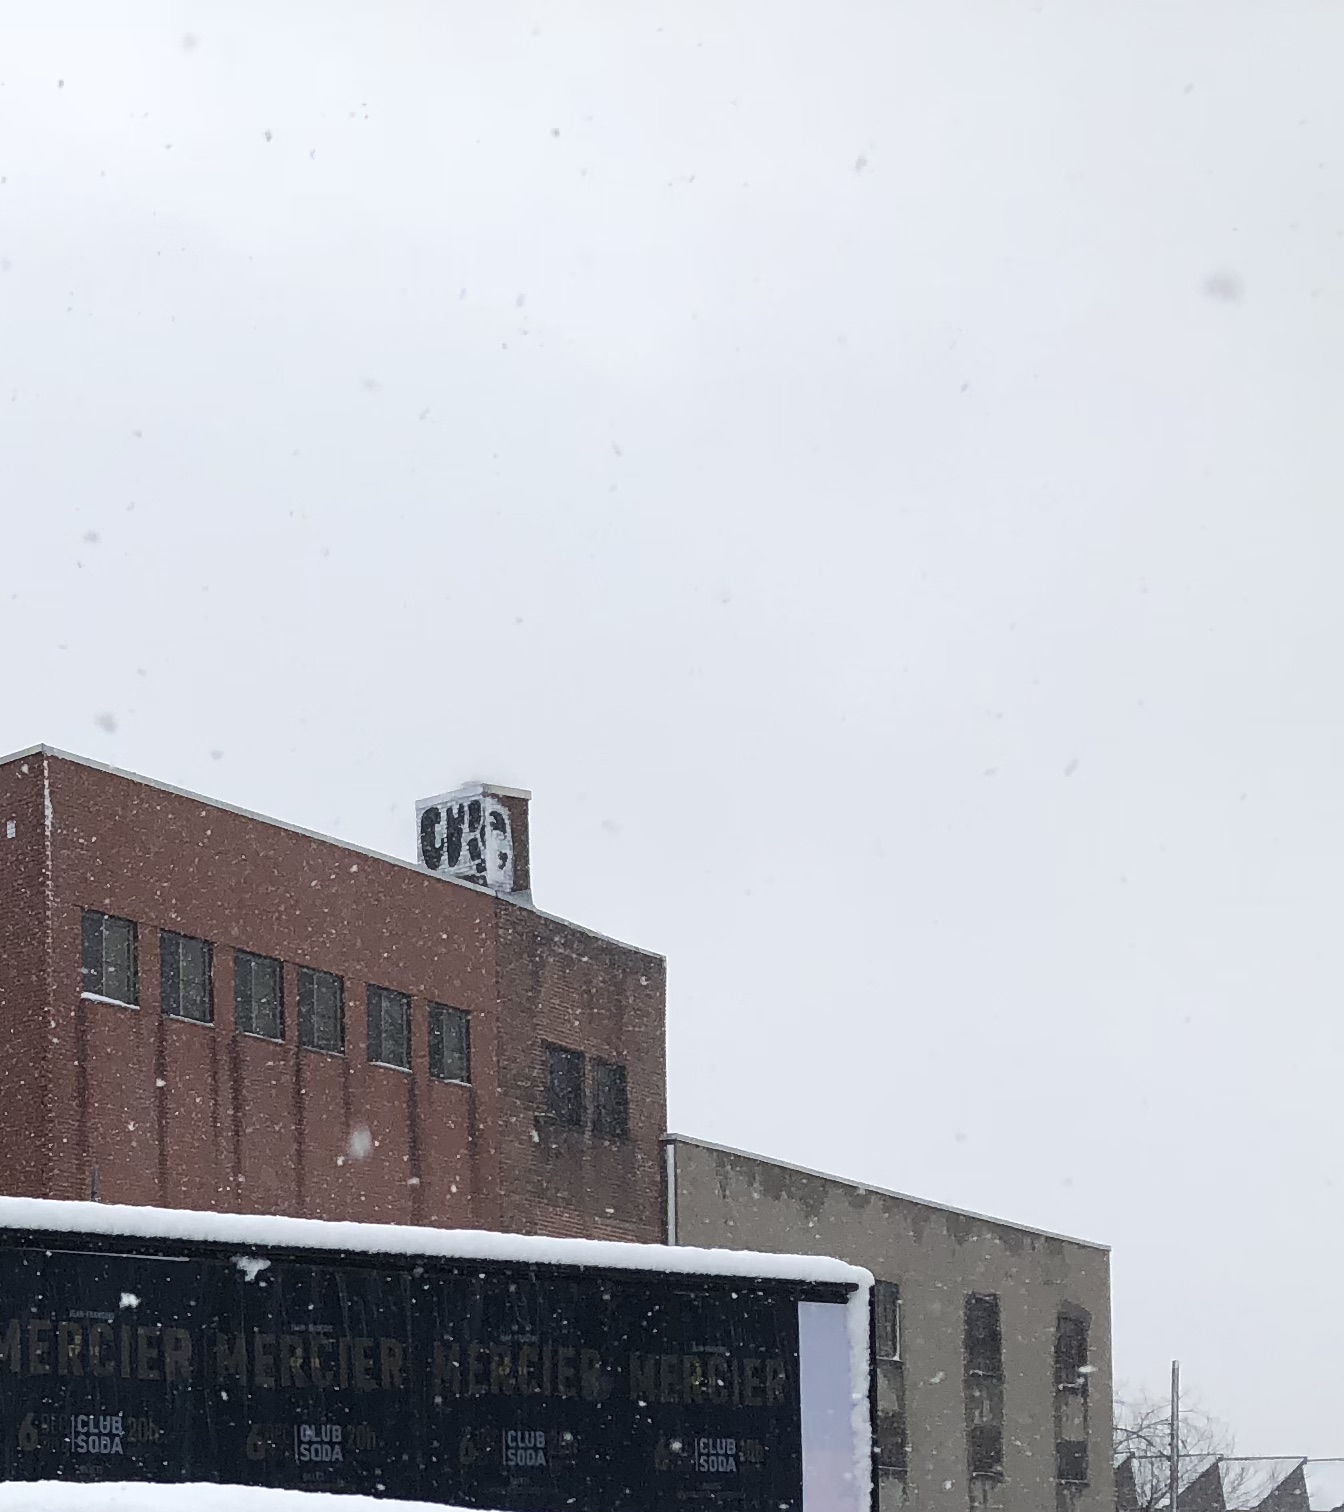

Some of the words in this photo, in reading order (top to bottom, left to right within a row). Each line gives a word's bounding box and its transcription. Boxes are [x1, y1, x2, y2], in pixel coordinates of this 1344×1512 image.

[216, 1333, 403, 1392] MERCIER
[433, 1342, 601, 1395] MERCIER
[629, 1353, 785, 1406] MERCIER
[77, 1414, 123, 1434] CLUB
[299, 1424, 342, 1442] CLUB
[77, 1435, 123, 1454] SODA
[507, 1429, 546, 1448] CLUB
[699, 1438, 736, 1454] CLUB
[299, 1444, 344, 1462] SODA
[507, 1449, 547, 1466] SODA
[699, 1456, 737, 1472] SODA
